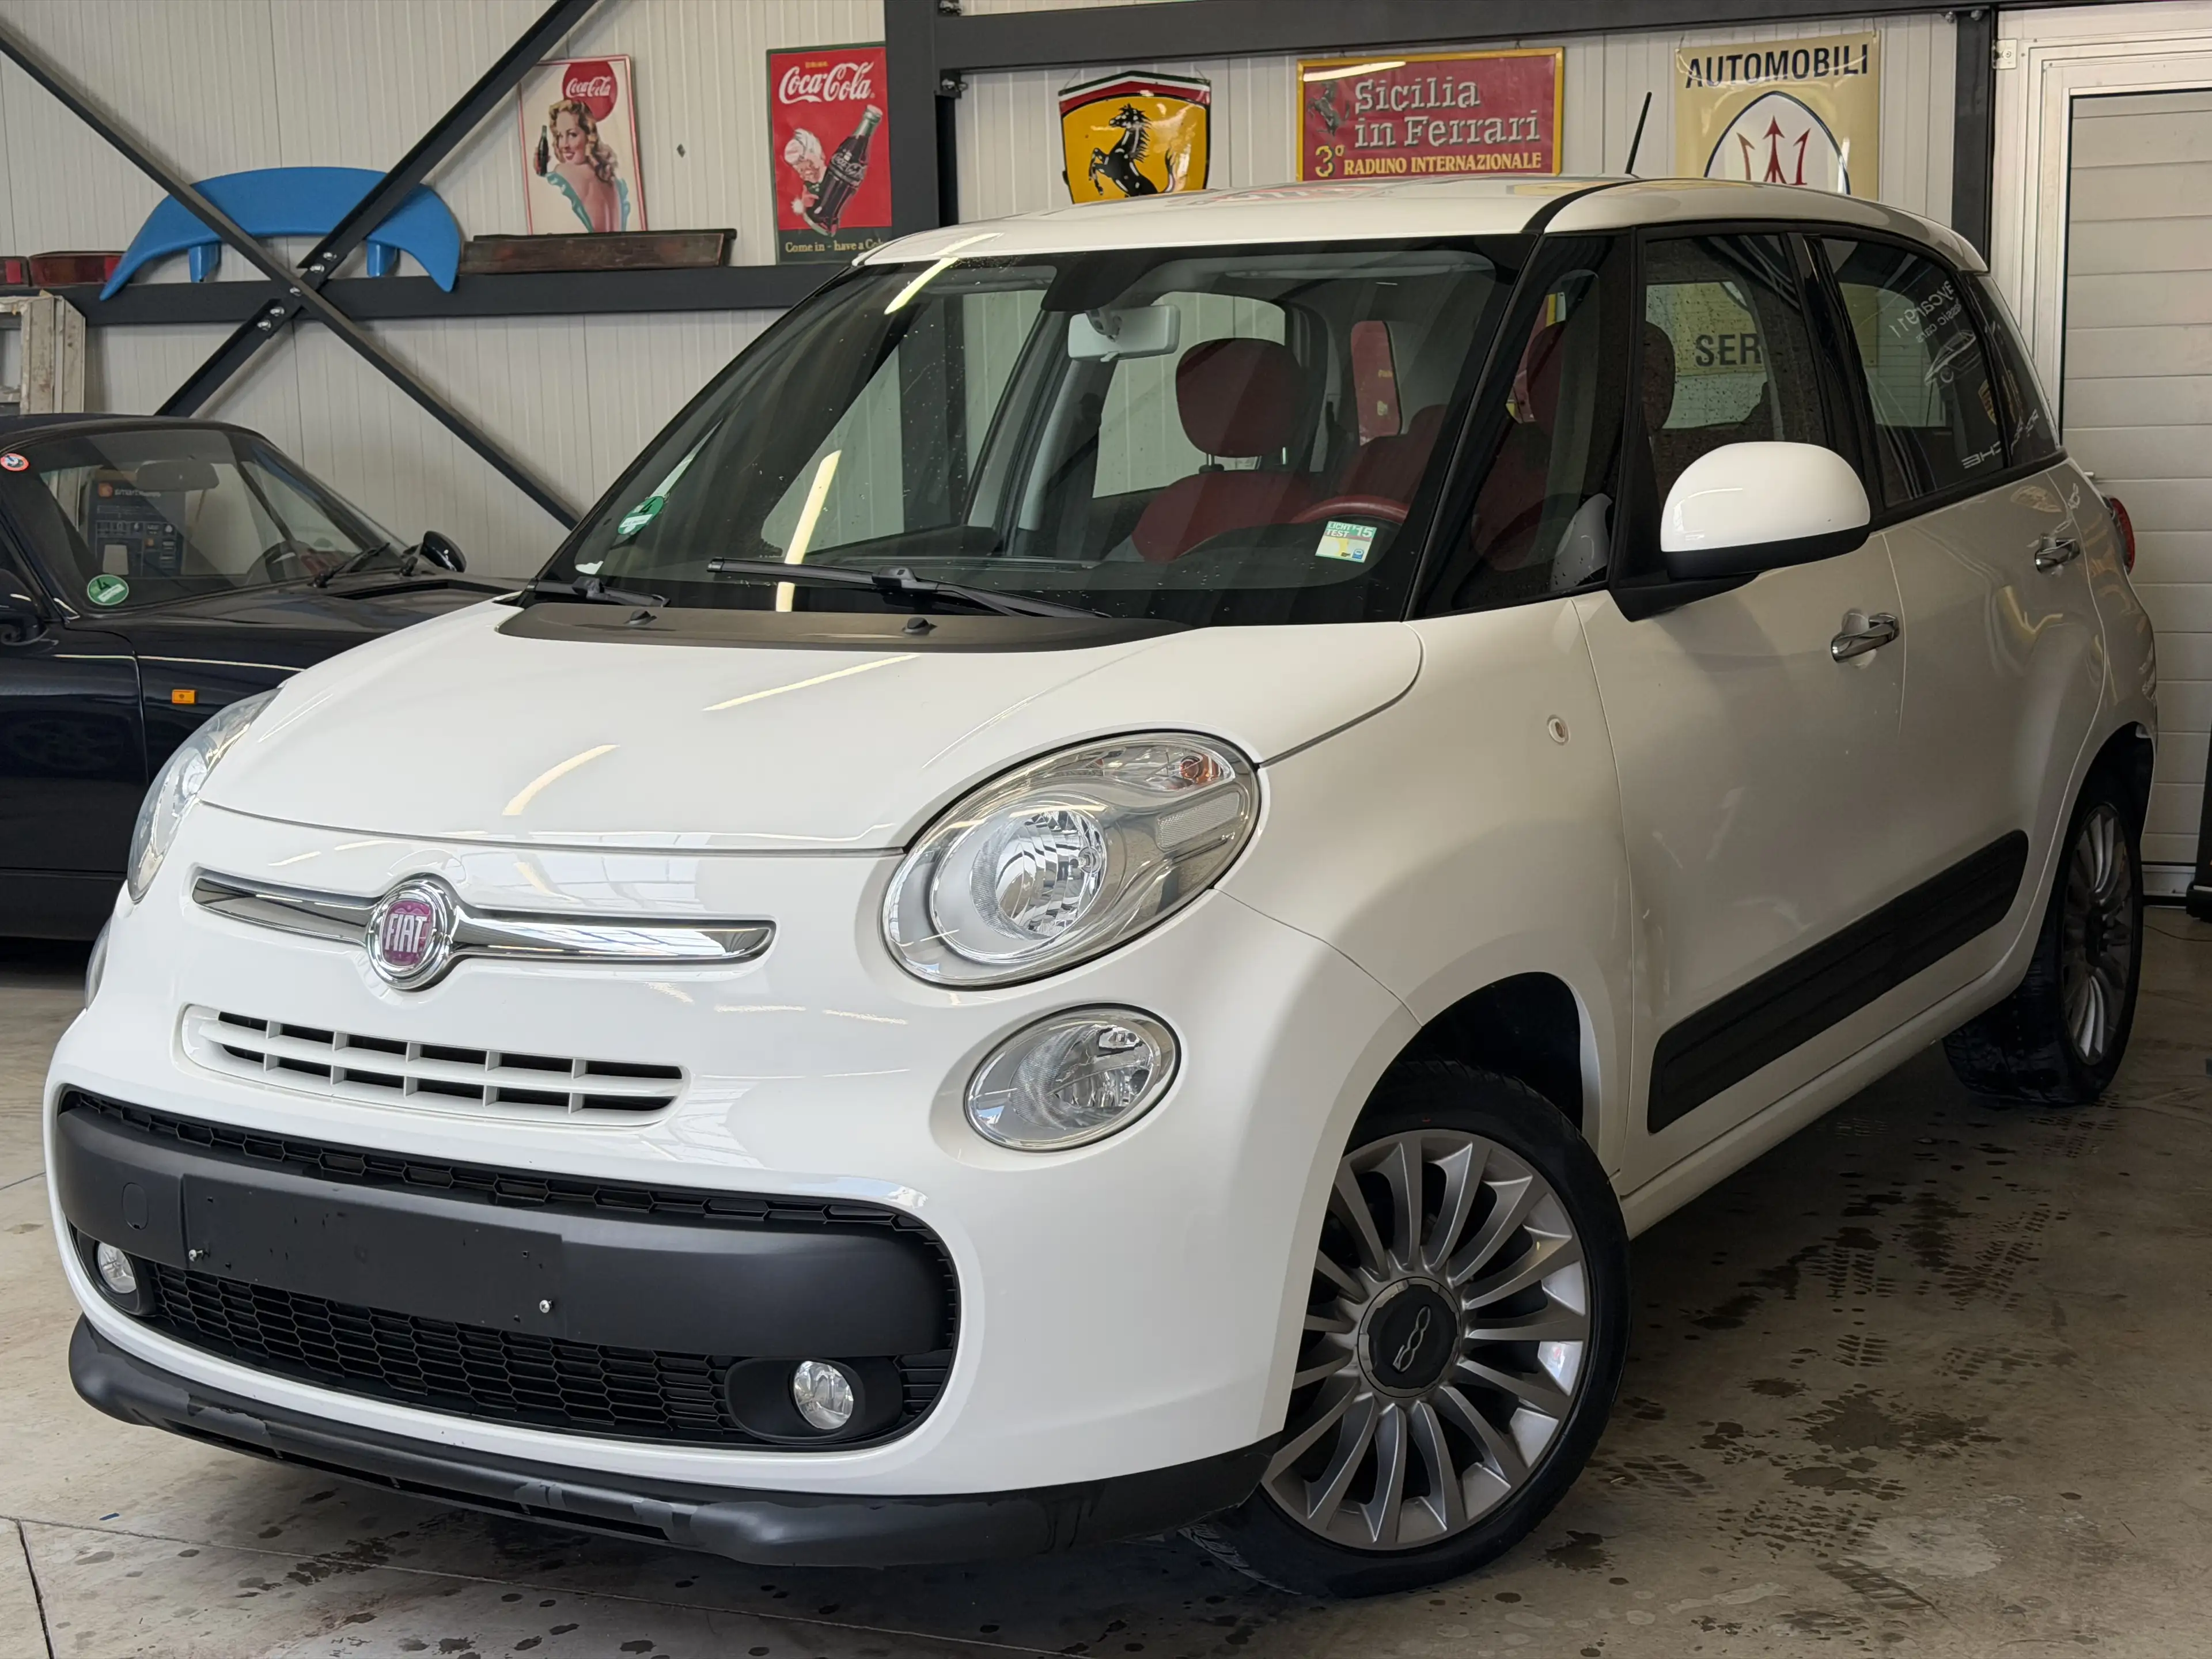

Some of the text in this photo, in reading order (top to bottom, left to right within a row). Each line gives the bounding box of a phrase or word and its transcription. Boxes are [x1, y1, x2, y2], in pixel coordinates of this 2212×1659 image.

[779, 60, 874, 105] Coca-Cola
[1685, 44, 1868, 89] AUTOMOBILI
[1355, 75, 1481, 115] Sicilia
[1354, 109, 1541, 149] in Ferrari
[1343, 157, 1407, 175] RADUNO
[1410, 152, 1542, 173] INTERNAZIONALE
[785, 241, 813, 252] Come
[815, 241, 825, 252] in
[834, 240, 858, 251] have
[858, 242, 865, 250] a
[1326, 528, 1350, 538] TEST
[1328, 522, 1351, 531] LICHT
[384, 913, 429, 953] FIAT
